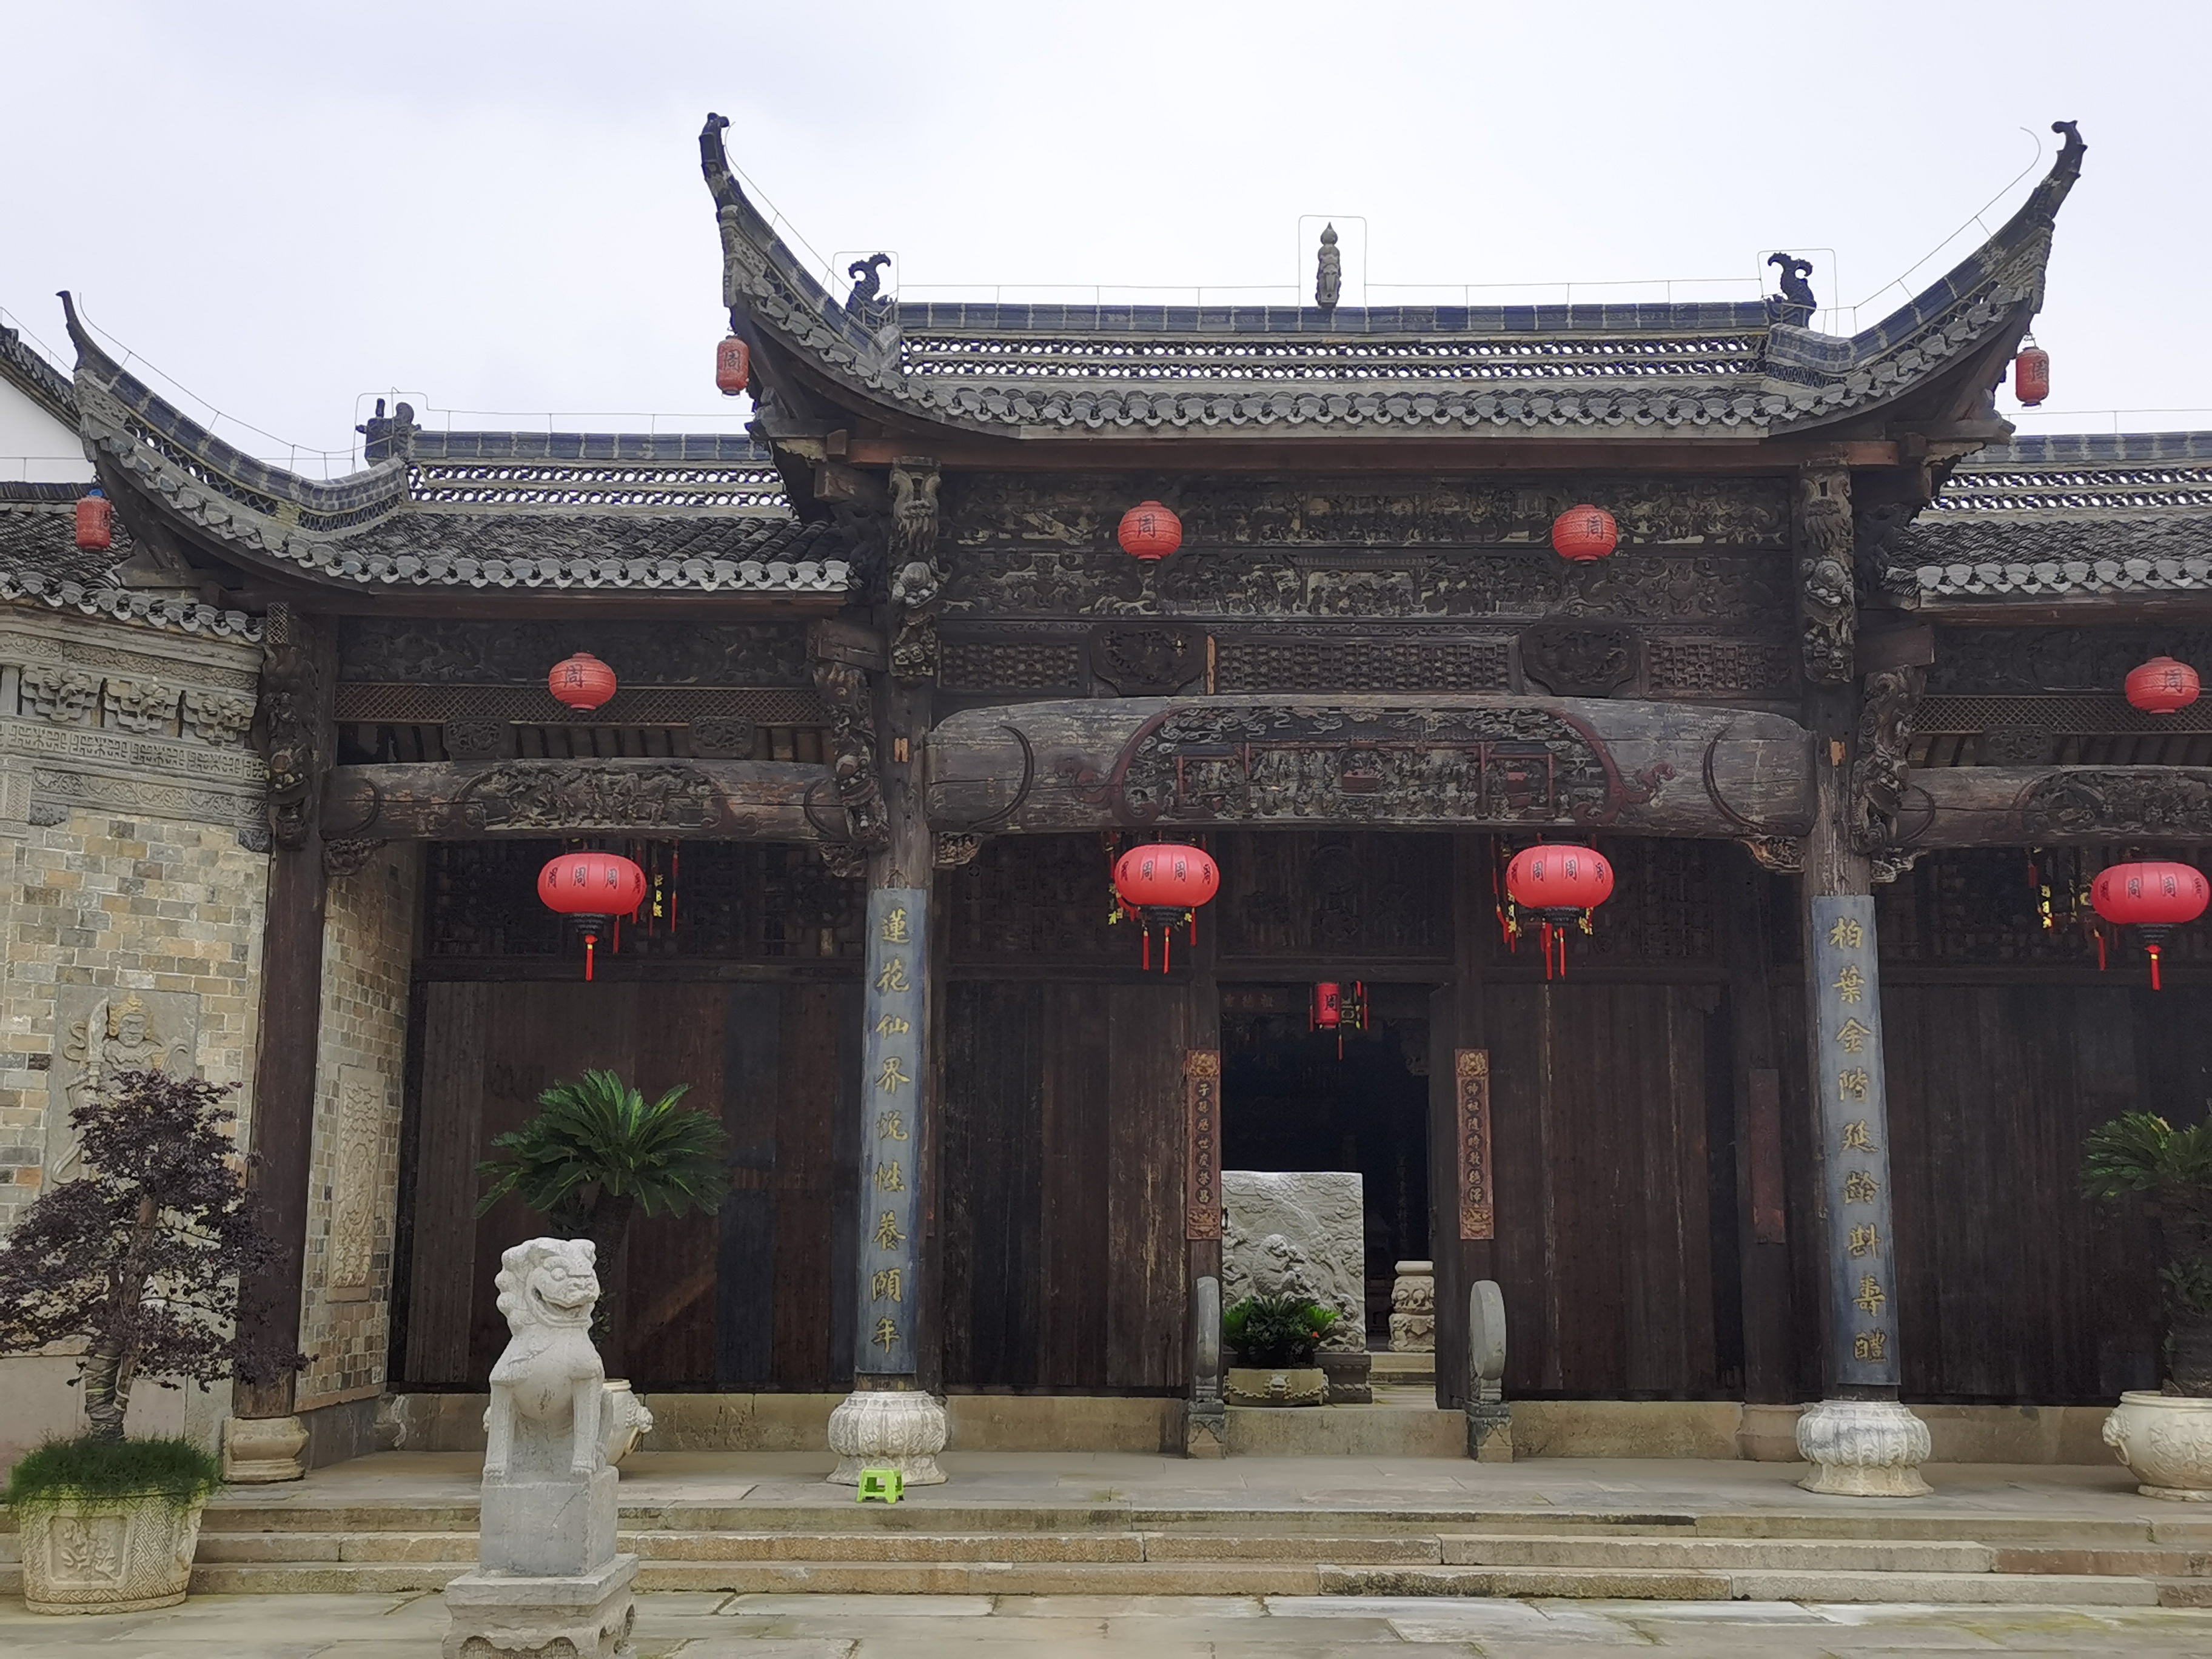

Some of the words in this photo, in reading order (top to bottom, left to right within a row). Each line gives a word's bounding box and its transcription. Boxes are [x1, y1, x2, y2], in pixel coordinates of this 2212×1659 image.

[723, 349, 741, 372] 周
[1138, 514, 1156, 538] 周
[1586, 515, 1603, 540] 周
[563, 663, 584, 688] 周
[2163, 668, 2183, 693] 周
[573, 866, 586, 887] 周
[605, 868, 618, 889] 周
[1141, 860, 1154, 881] 周
[1174, 861, 1186, 882] 周
[1533, 860, 1544, 882] 周
[1565, 859, 1577, 881] 周
[1324, 993, 1339, 1011] 周
